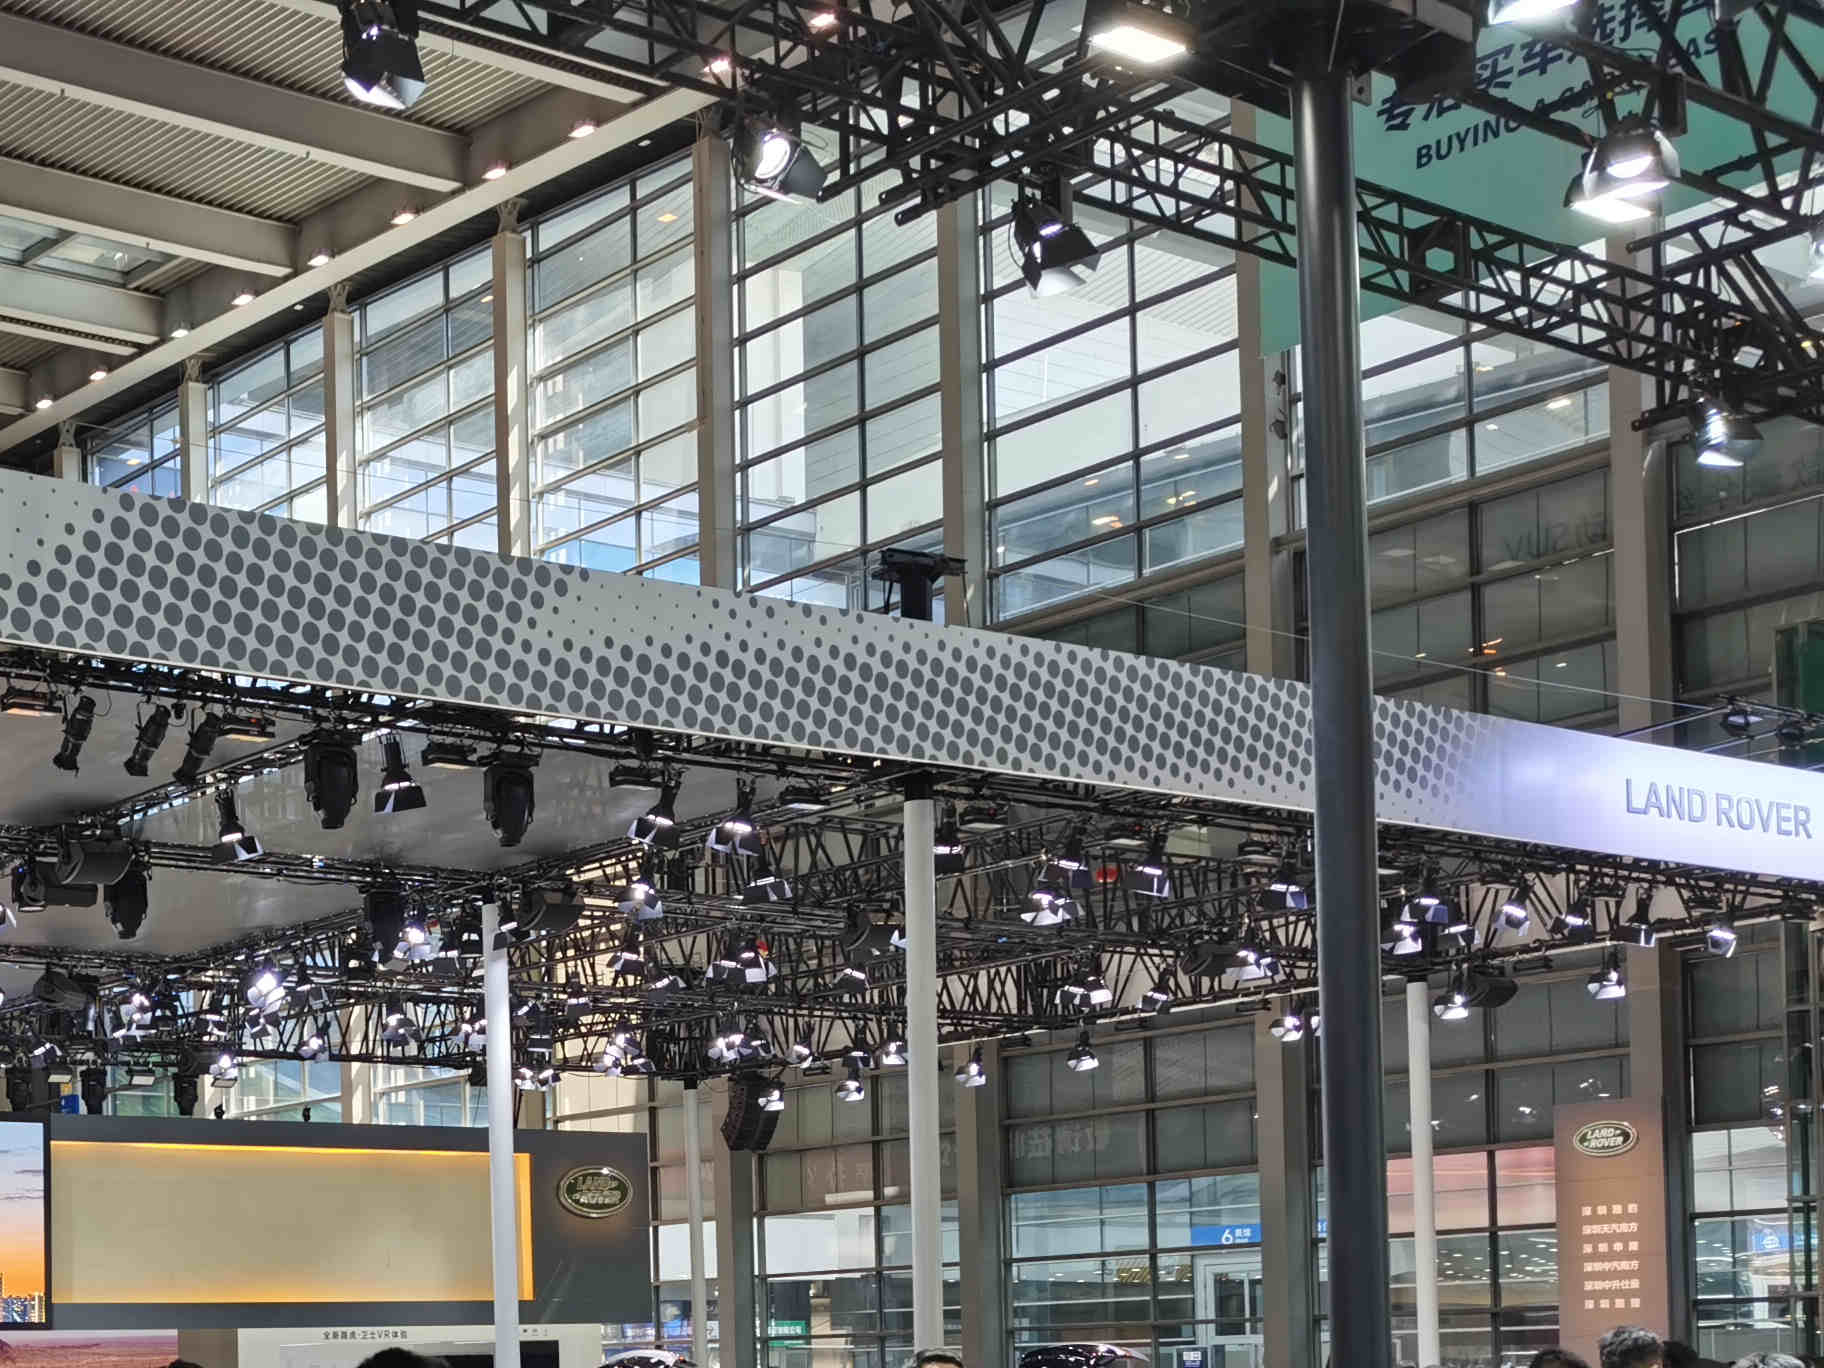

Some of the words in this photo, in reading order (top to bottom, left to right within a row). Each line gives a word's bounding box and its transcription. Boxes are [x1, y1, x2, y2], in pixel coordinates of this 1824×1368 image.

[1626, 778, 1706, 823] LAND
[1716, 793, 1812, 839] ROVER
[1587, 1128, 1615, 1139] LAND
[1589, 1137, 1624, 1148] ROVER
[1222, 1229, 1234, 1245] 6
